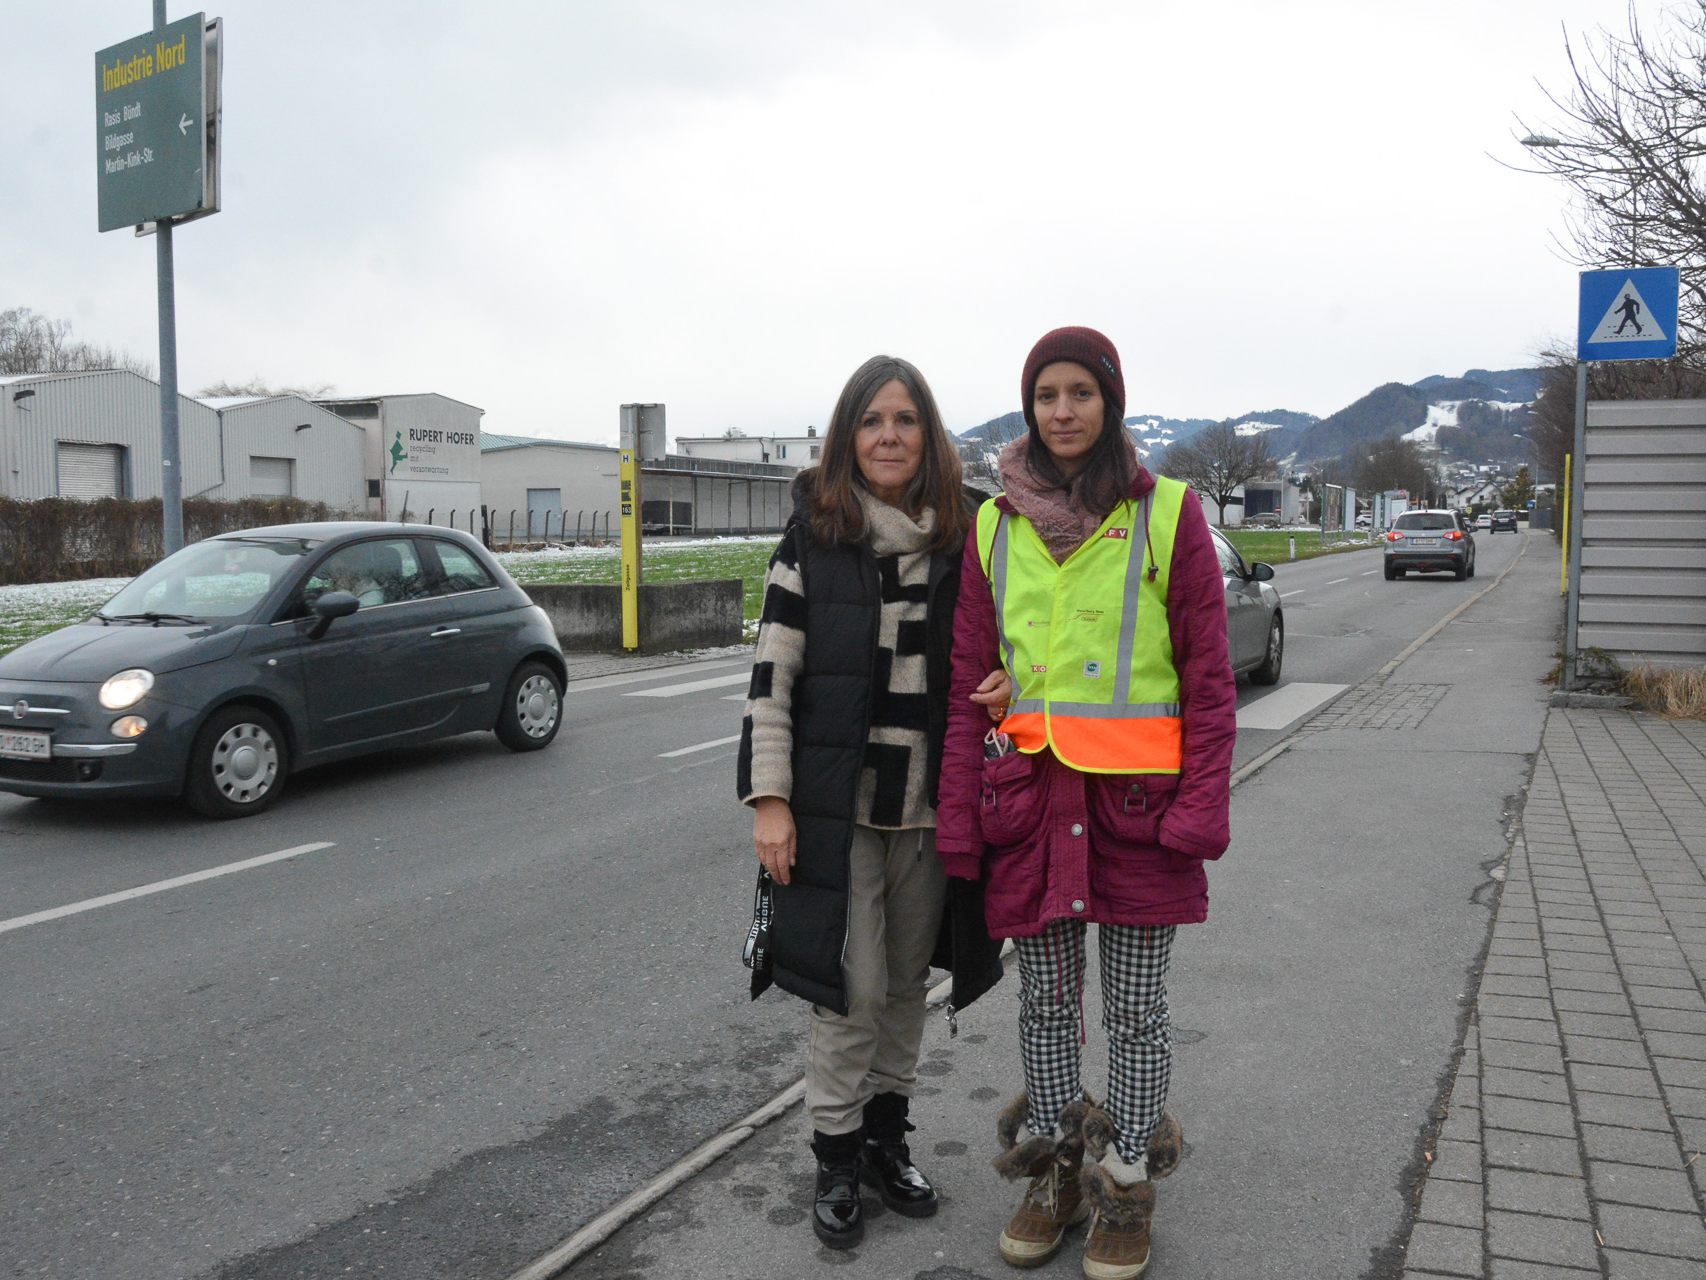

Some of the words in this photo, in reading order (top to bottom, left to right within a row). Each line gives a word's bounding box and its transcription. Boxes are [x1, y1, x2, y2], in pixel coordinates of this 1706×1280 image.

[103, 49, 152, 92] Industrie
[156, 34, 185, 73] Nord
[105, 132, 134, 152] Bildgasse
[409, 428, 443, 443] RUPERT
[446, 431, 475, 446] HOFER
[623, 455, 629, 463] H
